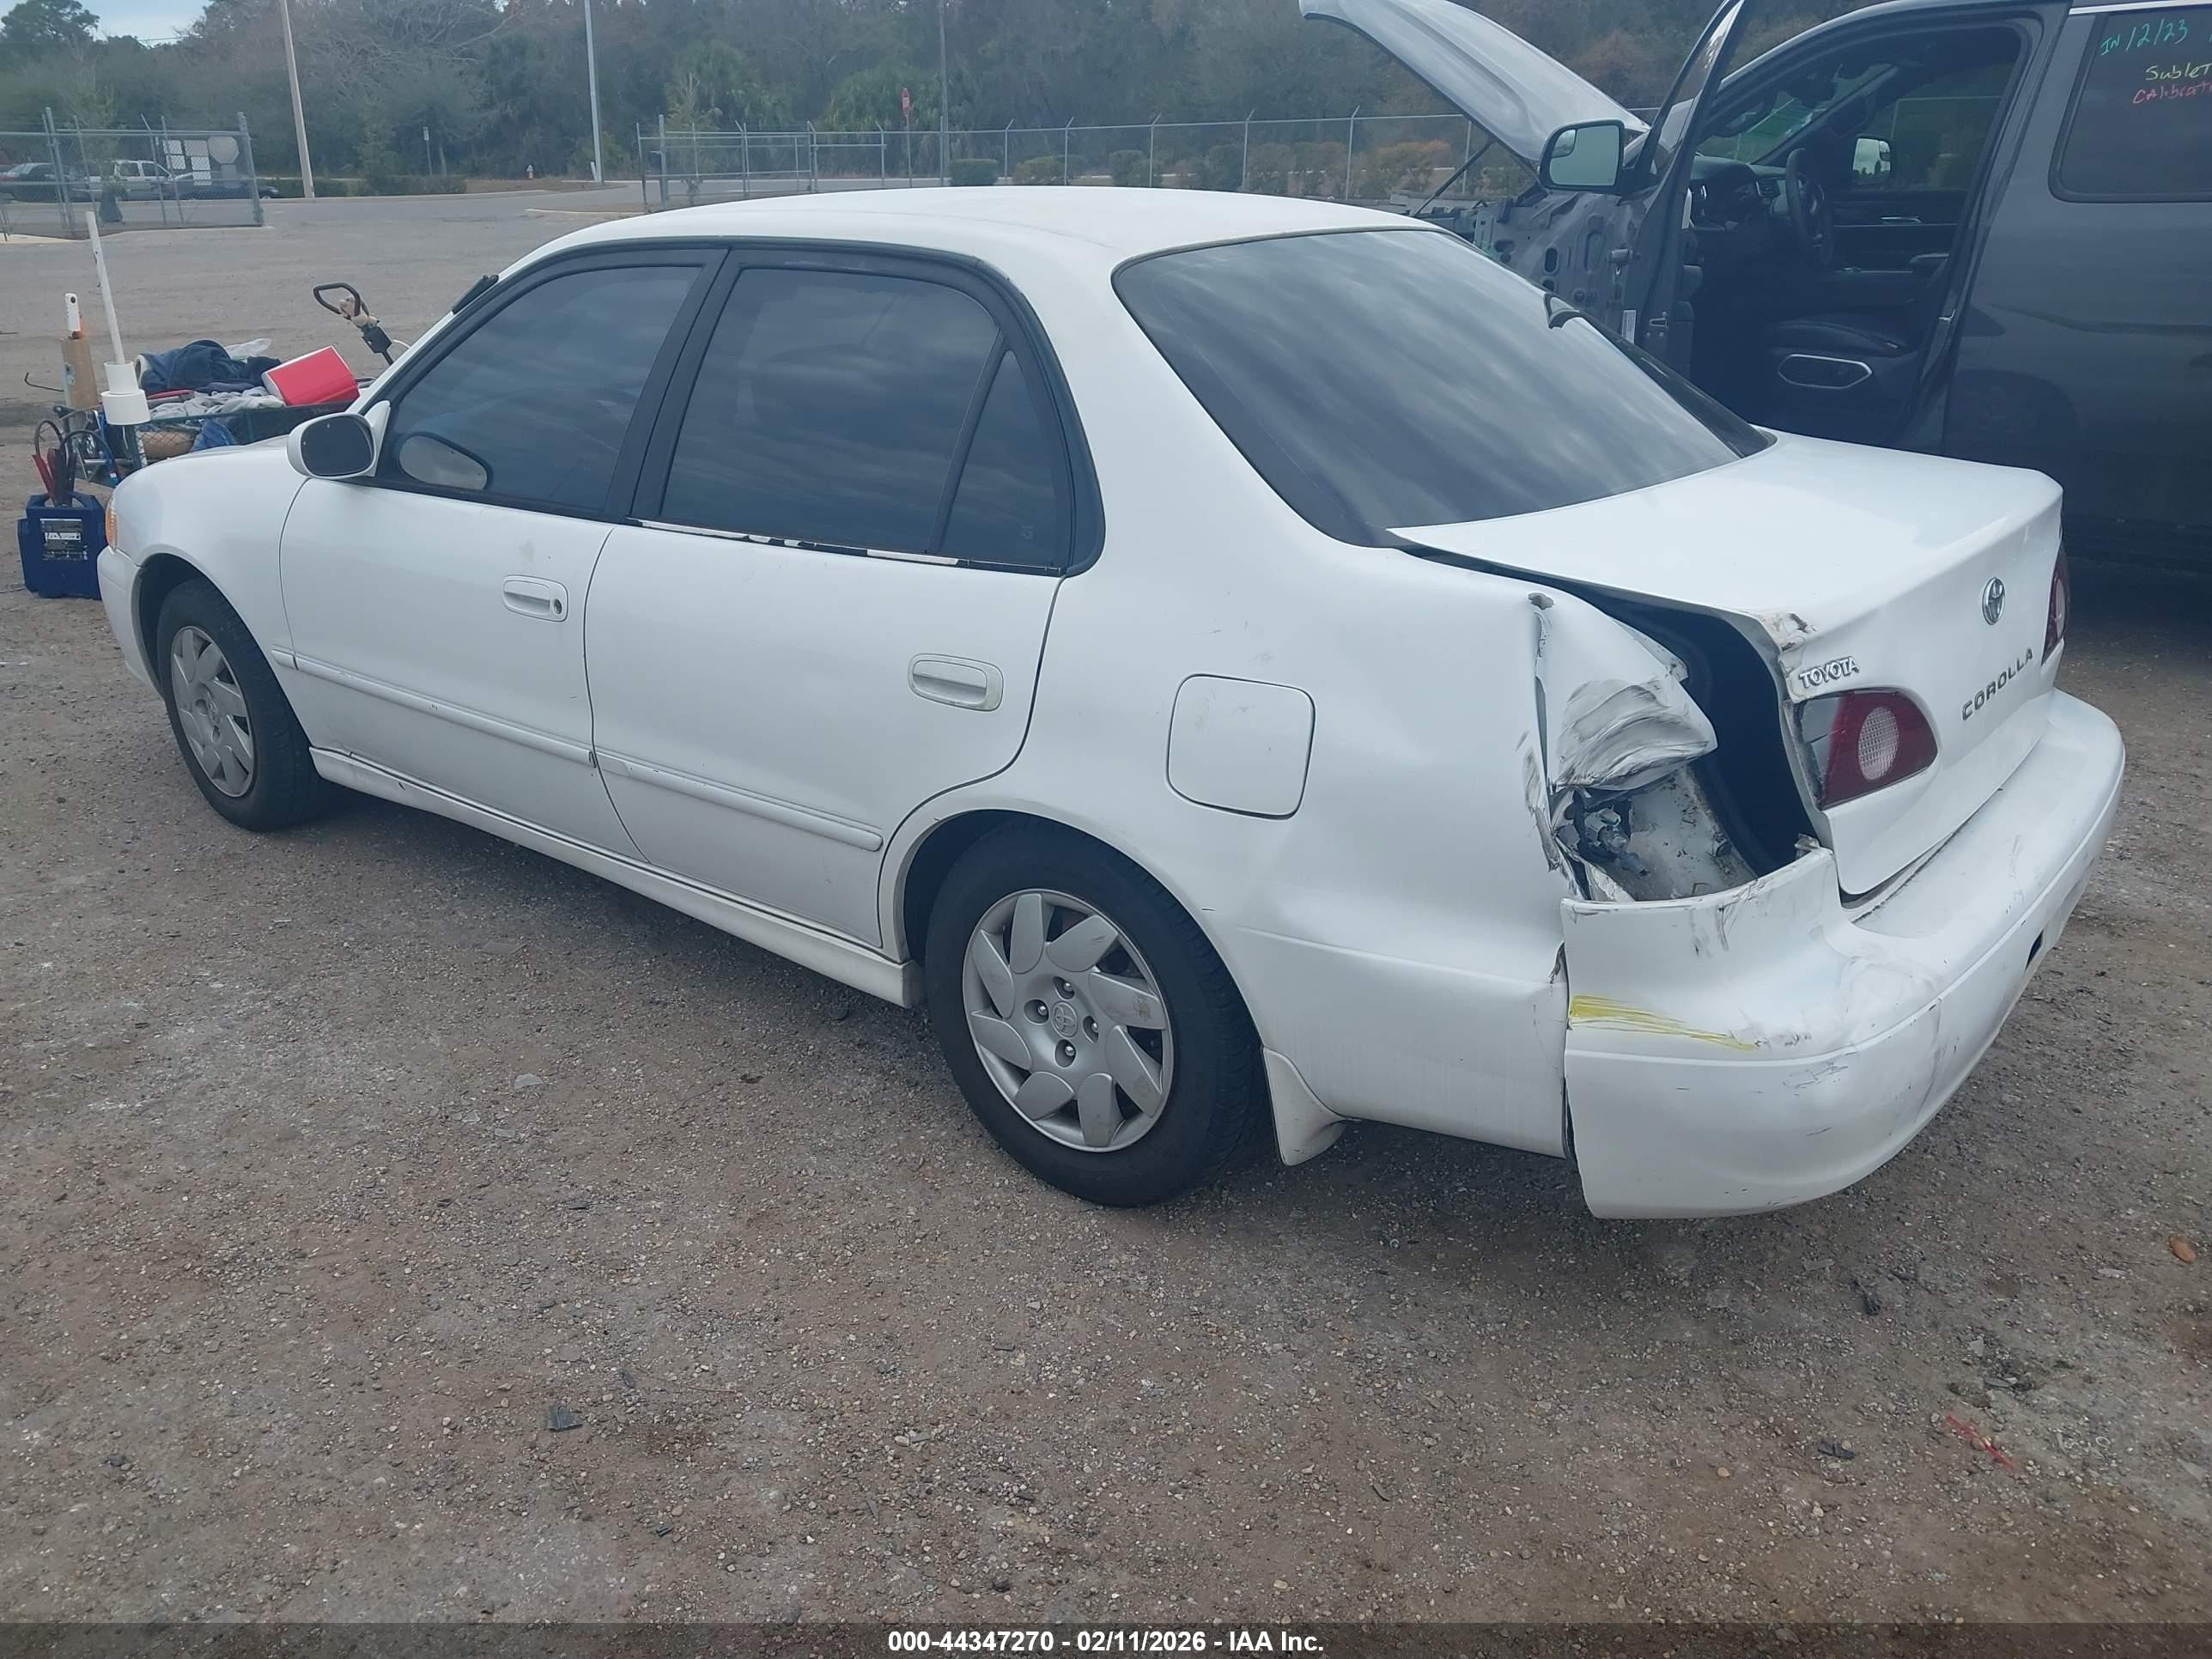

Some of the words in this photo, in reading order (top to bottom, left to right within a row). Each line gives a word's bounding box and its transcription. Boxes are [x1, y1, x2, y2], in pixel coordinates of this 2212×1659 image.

[2124, 18, 2189, 52] 12/23
[1799, 656, 1861, 690] TOYOTA
[1961, 647, 2033, 721] COROLLA
